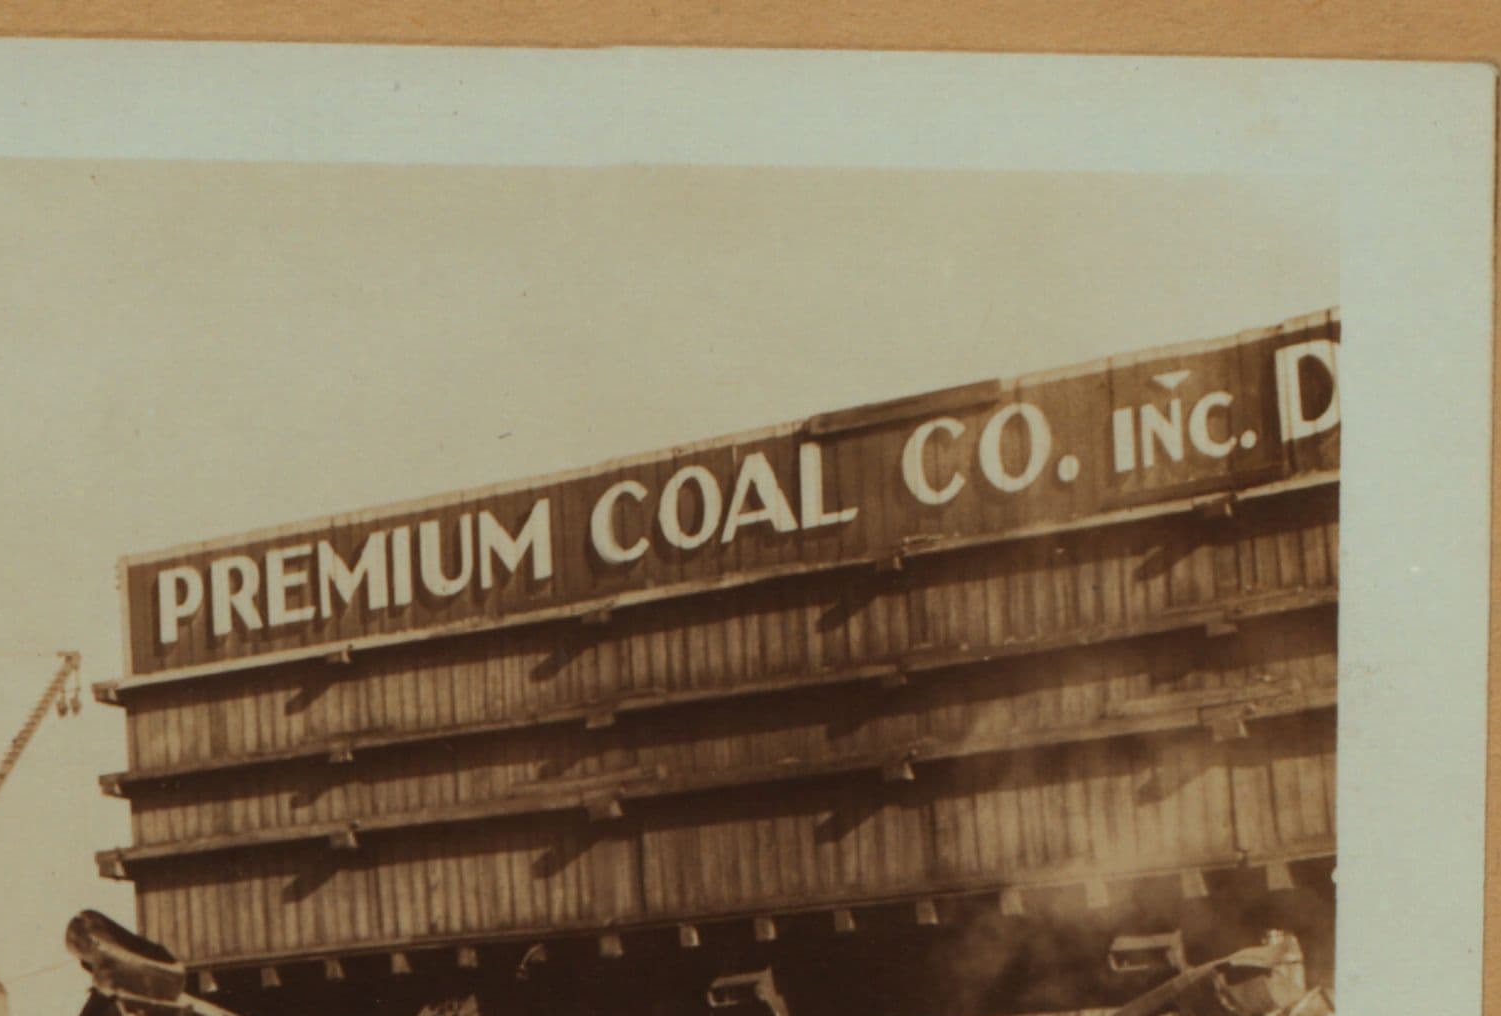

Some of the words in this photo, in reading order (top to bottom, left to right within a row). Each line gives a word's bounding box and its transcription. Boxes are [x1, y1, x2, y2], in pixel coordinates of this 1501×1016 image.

[158, 498, 552, 644] PREMIUM
[591, 443, 858, 562] COAL
[902, 402, 1080, 504] CO.
[1112, 390, 1257, 474] INC.
[1275, 339, 1341, 443] D
